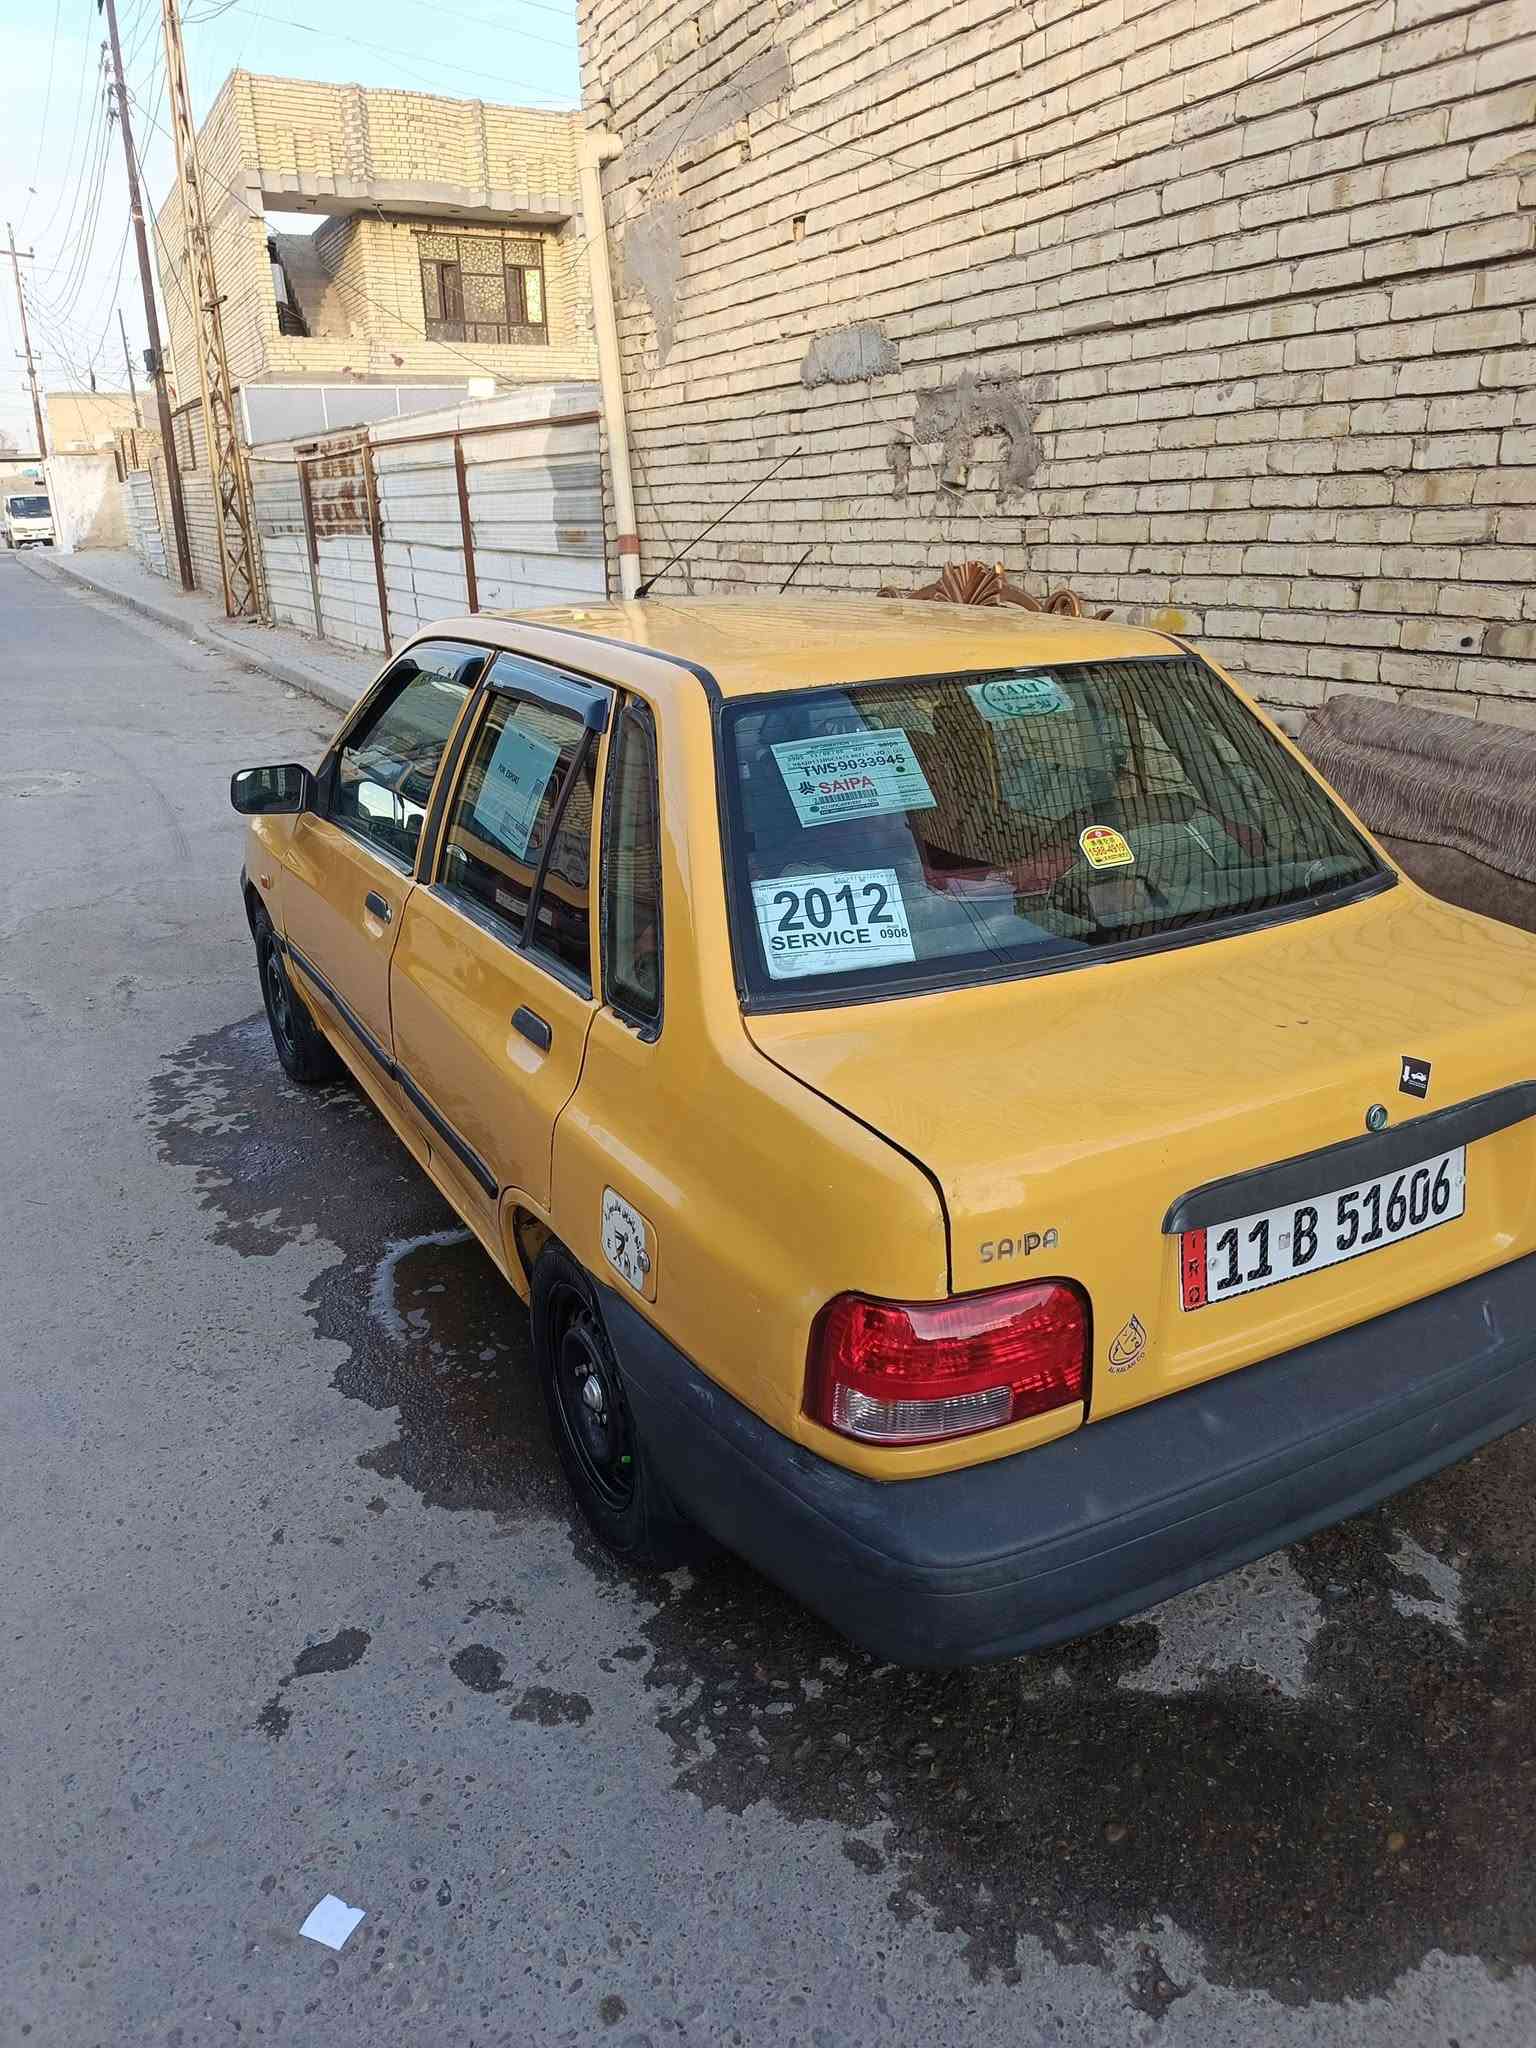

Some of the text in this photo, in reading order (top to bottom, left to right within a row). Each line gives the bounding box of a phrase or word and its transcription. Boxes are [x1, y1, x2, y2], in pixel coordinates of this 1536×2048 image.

[992, 683, 1039, 696] TAXI
[800, 753, 906, 777] TWS9033945
[817, 775, 875, 795] SAIPA
[773, 882, 894, 932] 2012
[771, 927, 909, 951] SERVICE 0908
[1216, 1158, 1450, 1291] 11 B 51606
[979, 1227, 1060, 1264] SAIPA
